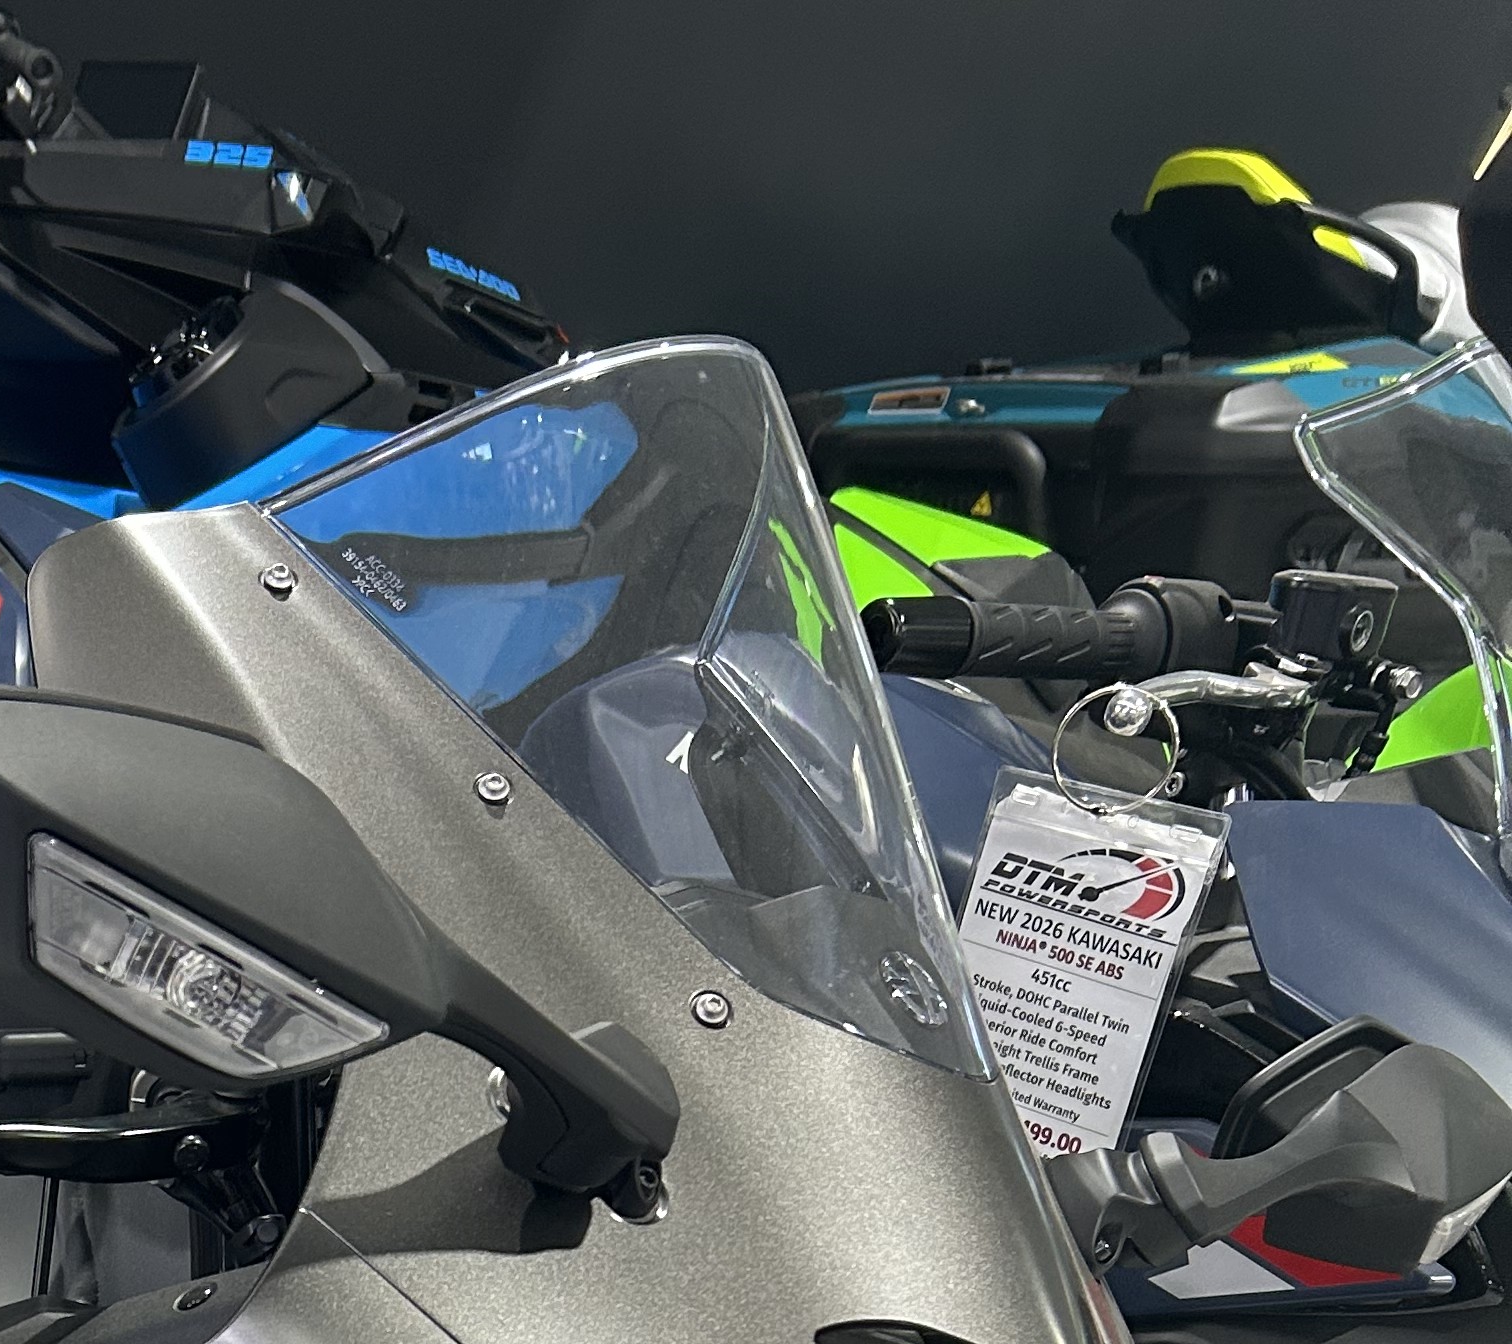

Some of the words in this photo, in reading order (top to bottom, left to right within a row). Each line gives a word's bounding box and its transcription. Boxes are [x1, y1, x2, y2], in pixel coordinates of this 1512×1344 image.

[184, 140, 273, 168] 325
[991, 853, 1085, 897] DTM
[983, 879, 1168, 939] POWERSPORTS
[975, 898, 1020, 925] NEW
[1020, 913, 1065, 939] 2026
[1067, 926, 1163, 970] KAWASAKI
[1048, 945, 1075, 965] 500
[1076, 955, 1095, 971] SE
[1095, 961, 1125, 980] ABS
[1031, 969, 1072, 993] 451cc
[1016, 988, 1052, 1008] DOHC
[1053, 1000, 1100, 1024] Parallel
[1102, 1014, 1130, 1034] Twin
[1019, 1029, 1046, 1047] Ride
[1048, 1039, 1098, 1065] Comfort
[1055, 1023, 1107, 1047] 6-Speed
[1025, 1051, 1060, 1072] Trellis
[1062, 1064, 1099, 1085] Frame
[1033, 1097, 1081, 1123] Warranty
[1046, 1079, 1112, 1110] Headlights
[1024, 1120, 1082, 1154] 99.00
